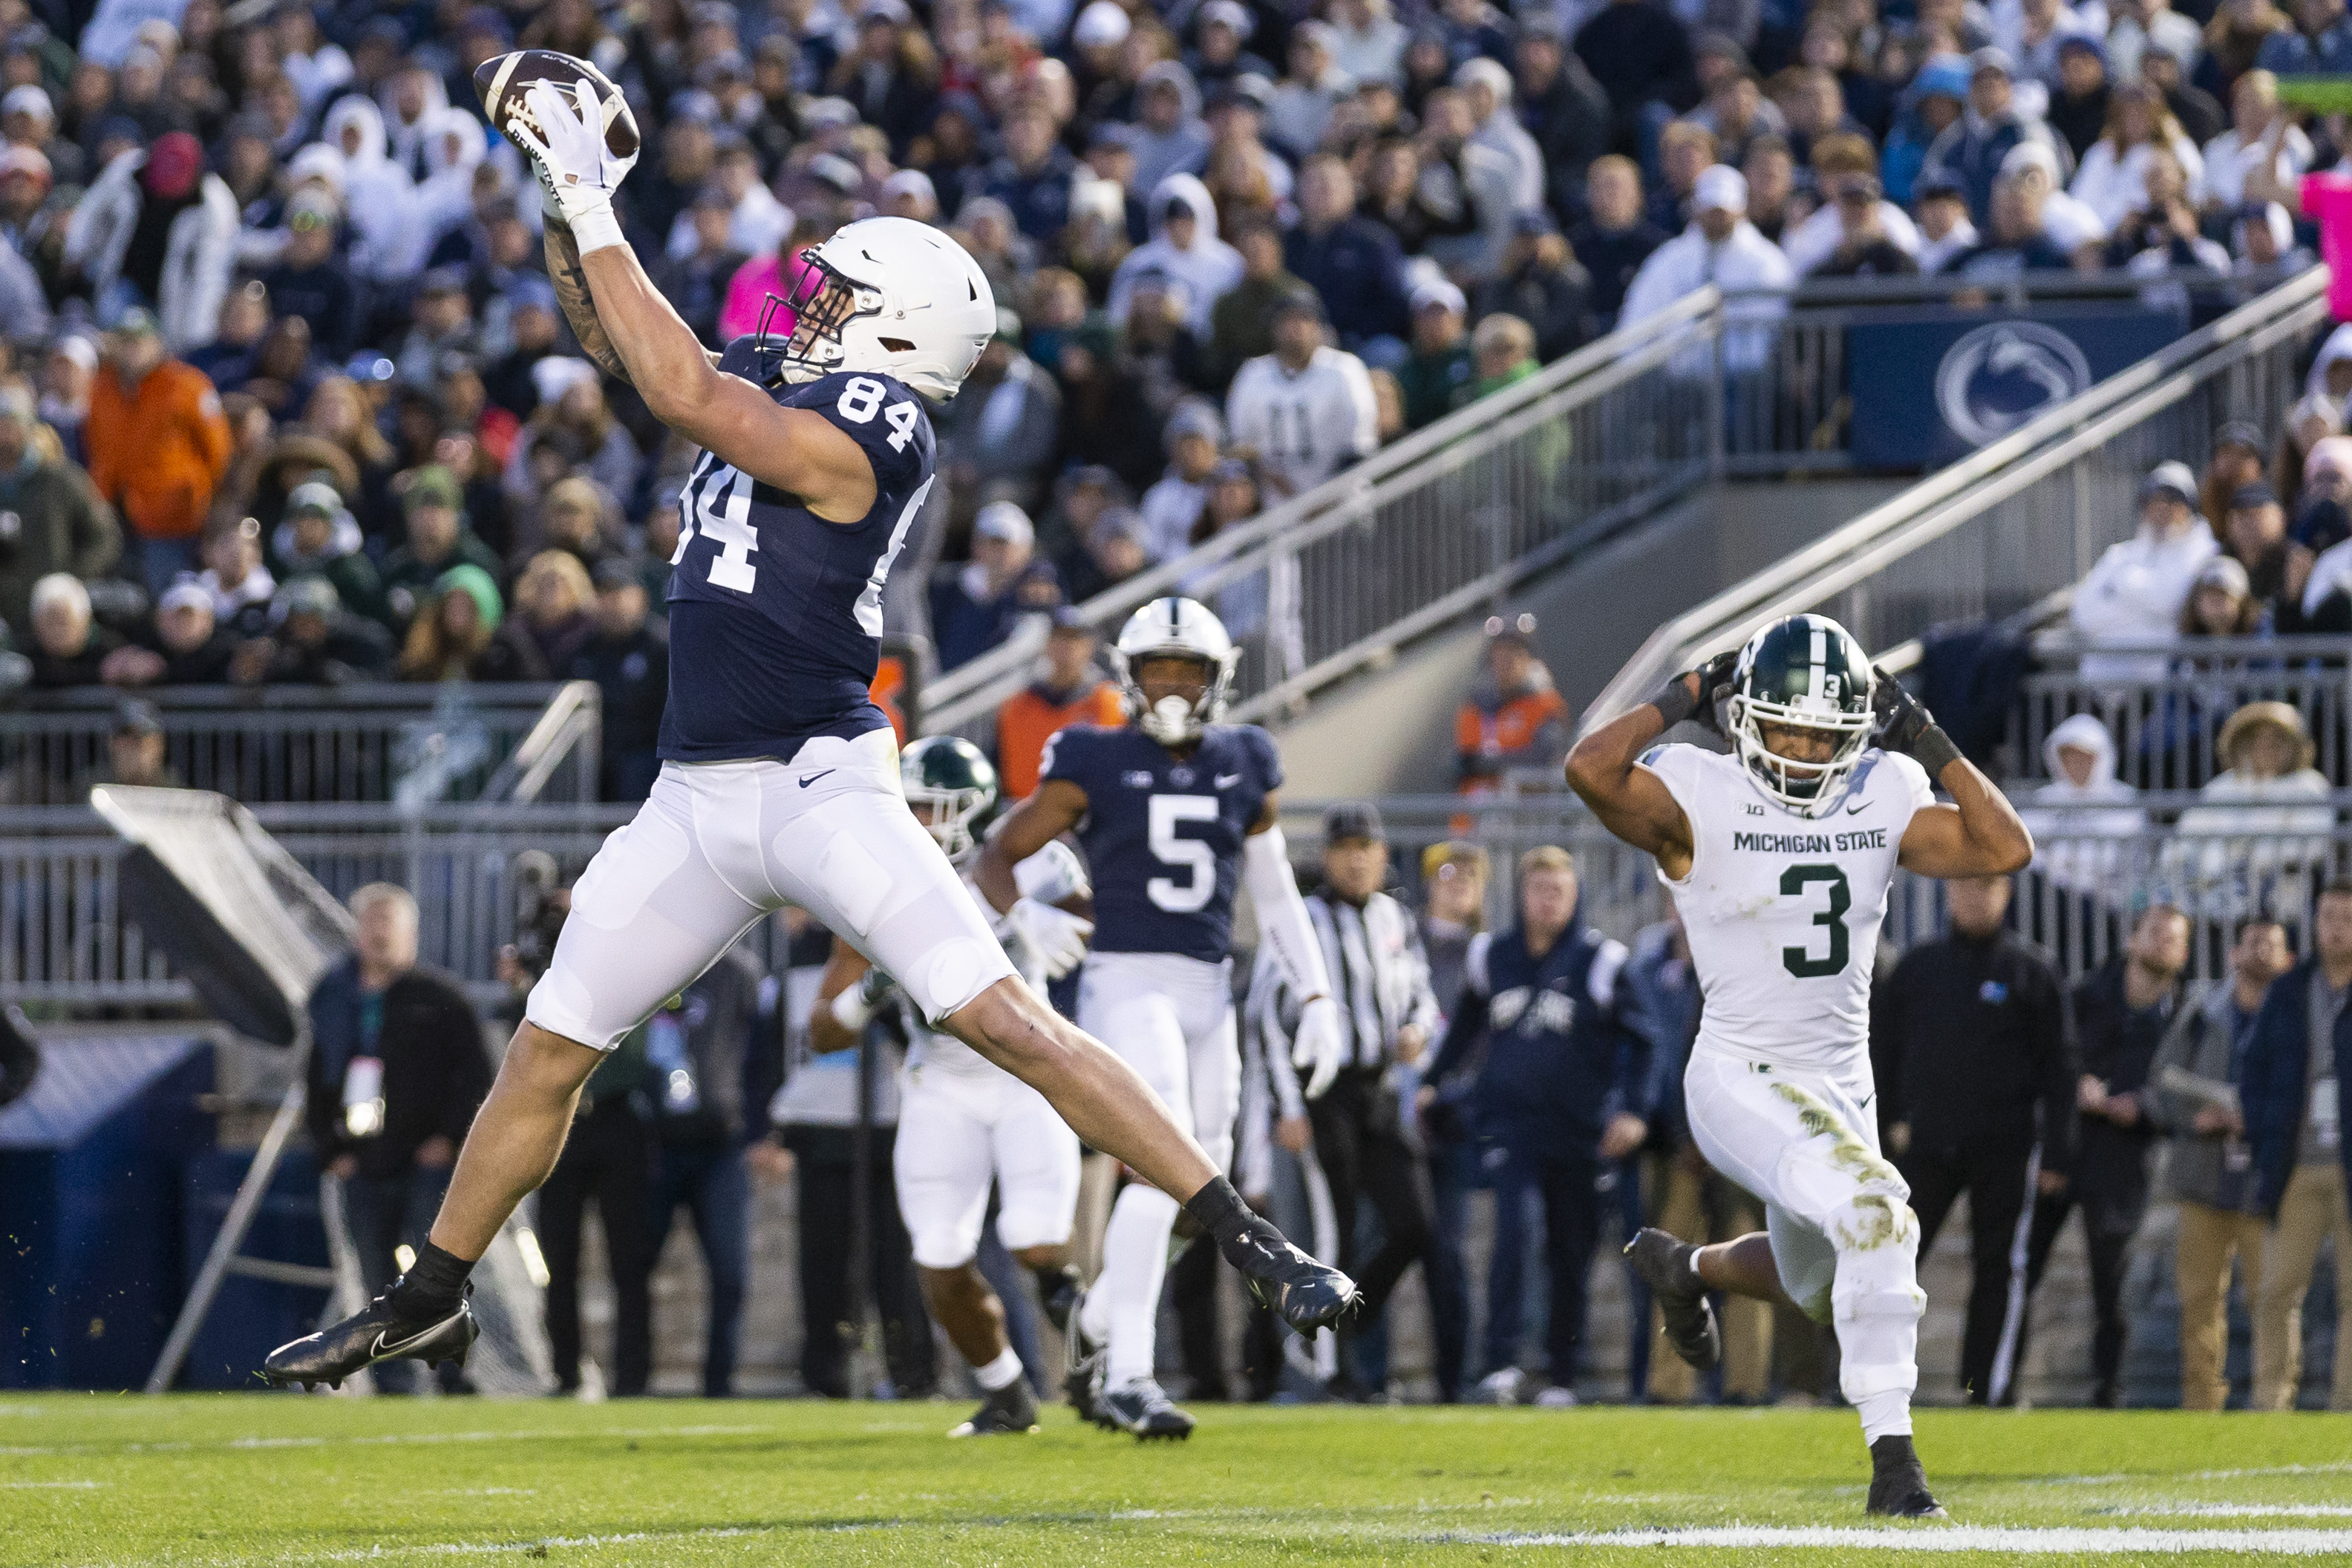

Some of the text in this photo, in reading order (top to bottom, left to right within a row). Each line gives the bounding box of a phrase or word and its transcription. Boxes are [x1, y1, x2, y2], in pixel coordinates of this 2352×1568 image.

[837, 376, 918, 454] 84
[1824, 674, 1841, 699] 3
[1147, 794, 1219, 913] 5
[1734, 828, 1887, 852] MICHIGAN STATE
[1780, 863, 1851, 978] 3
